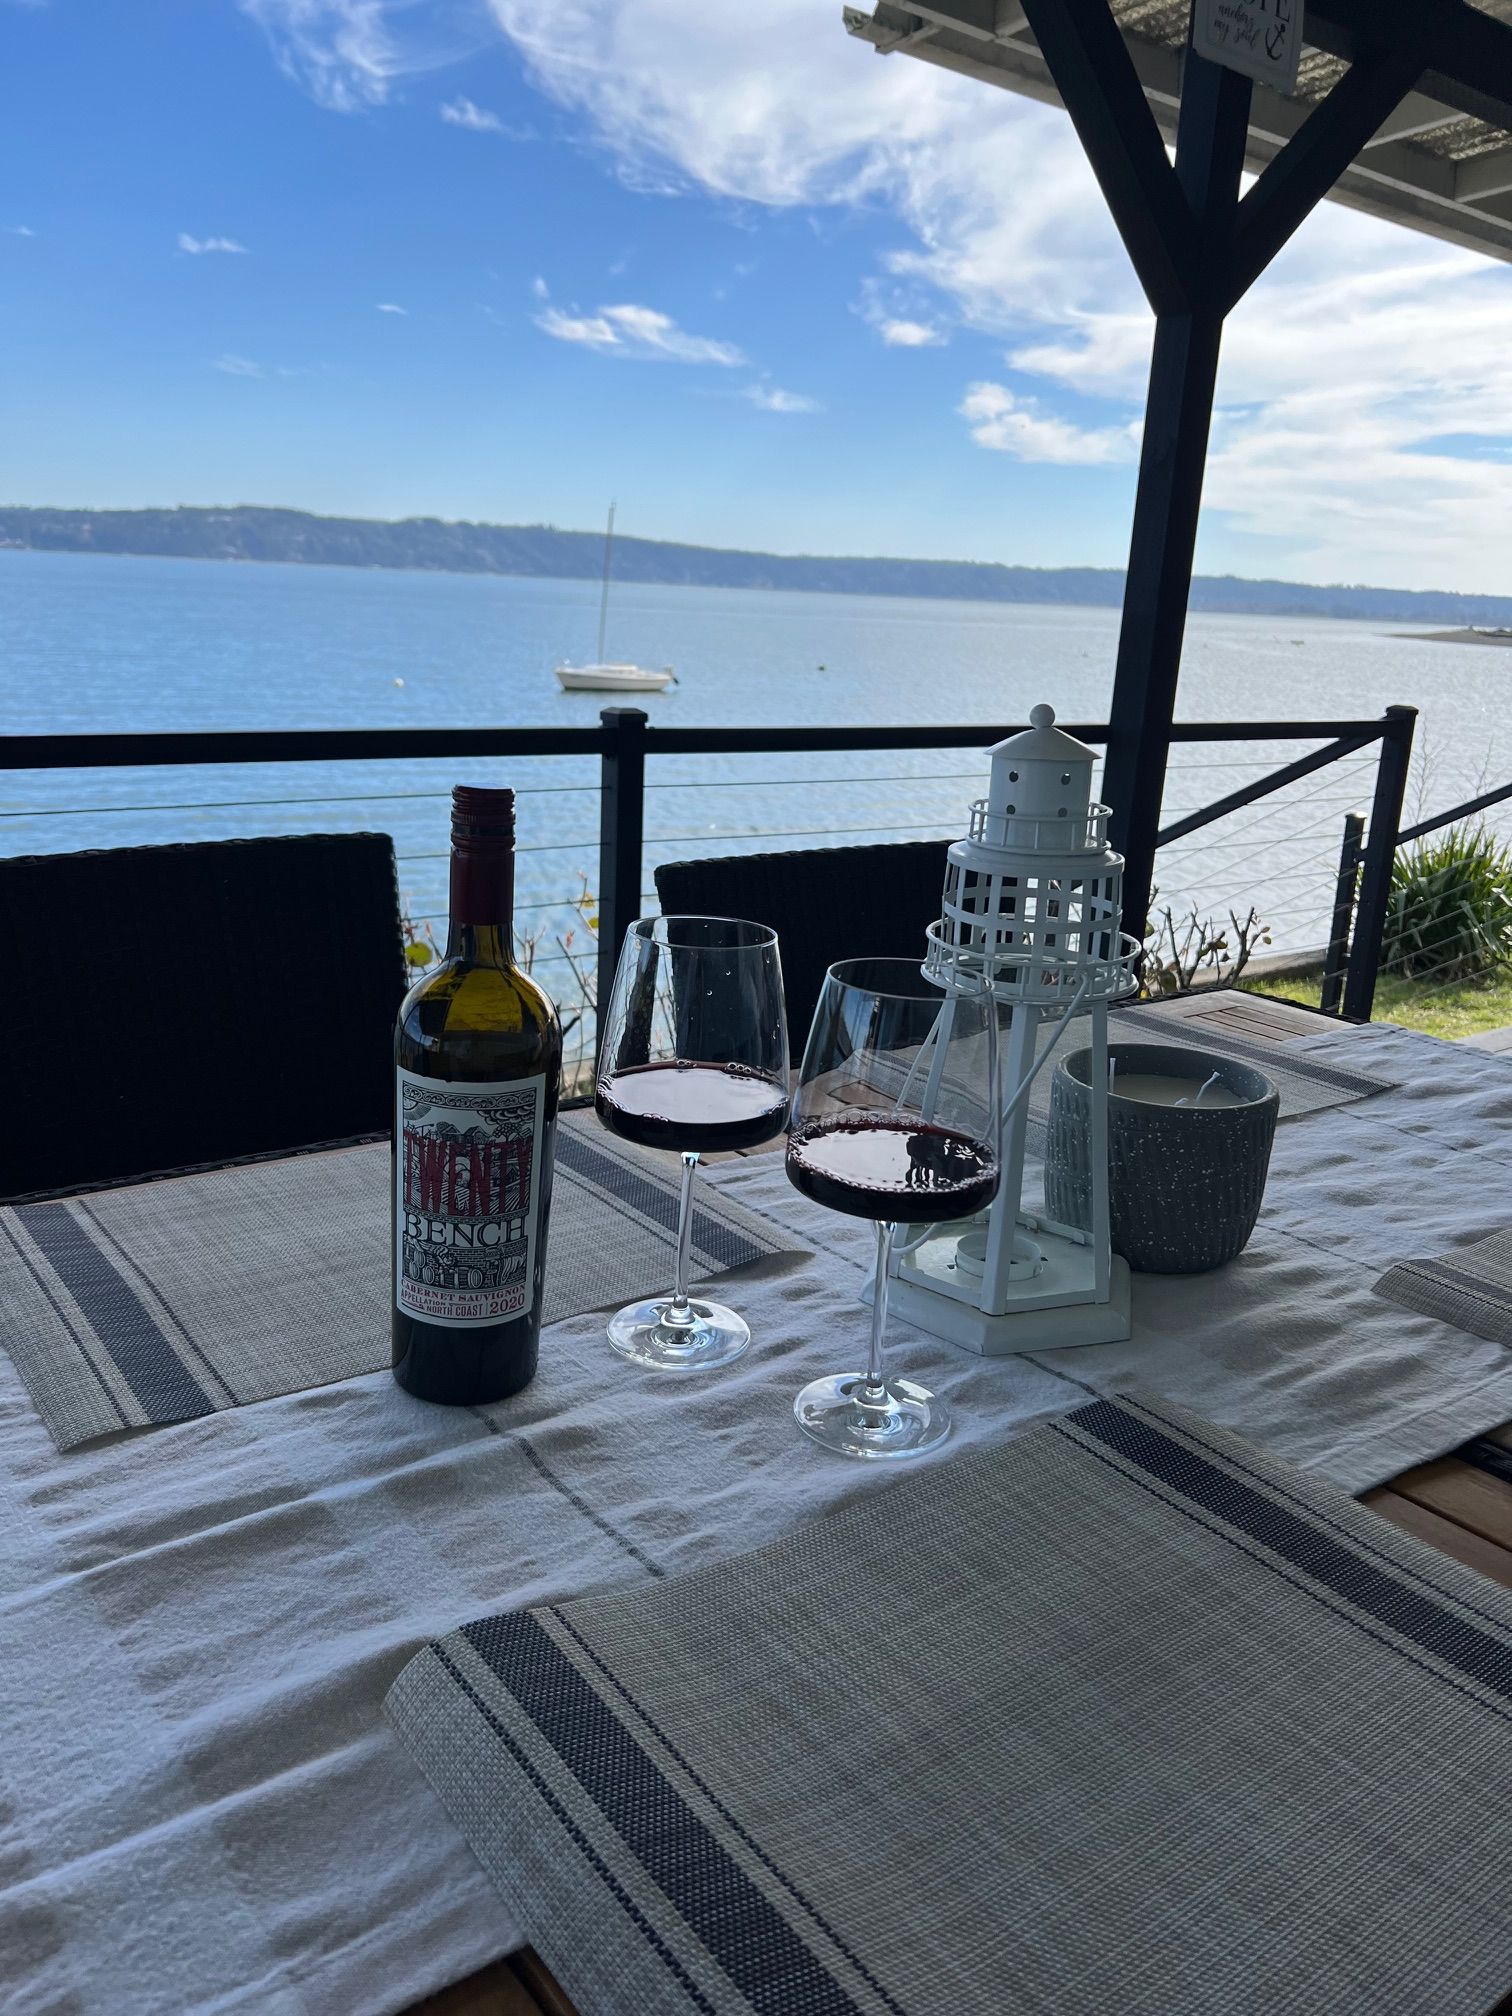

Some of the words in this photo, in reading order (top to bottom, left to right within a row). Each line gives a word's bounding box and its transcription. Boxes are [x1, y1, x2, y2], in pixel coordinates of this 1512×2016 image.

[403, 1127, 533, 1216] TWENTY
[405, 1212, 525, 1247] BENCH
[400, 1279, 456, 1301] CABERNET
[458, 1282, 526, 1302] SAUVIGNON
[400, 1288, 446, 1307] APPELLATION
[426, 1304, 453, 1316] NORTH
[455, 1303, 484, 1317] COAST
[489, 1292, 525, 1315] 2020
